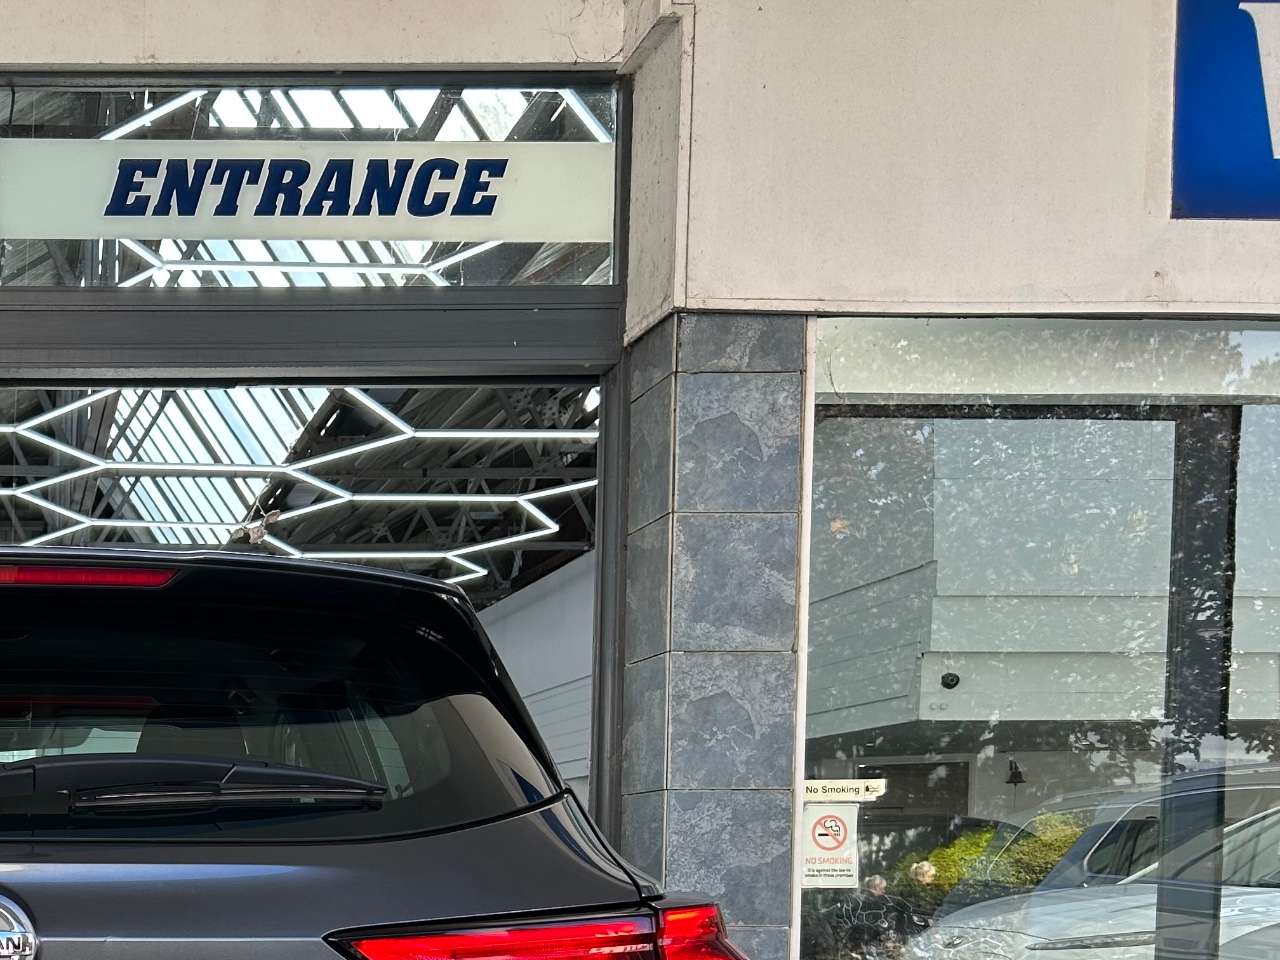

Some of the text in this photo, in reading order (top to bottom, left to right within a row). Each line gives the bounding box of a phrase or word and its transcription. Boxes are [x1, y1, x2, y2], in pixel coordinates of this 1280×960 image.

[103, 157, 509, 218] ENTRANCE
[805, 785, 860, 796] No Smoking
[805, 857, 853, 865] NO SMOKING
